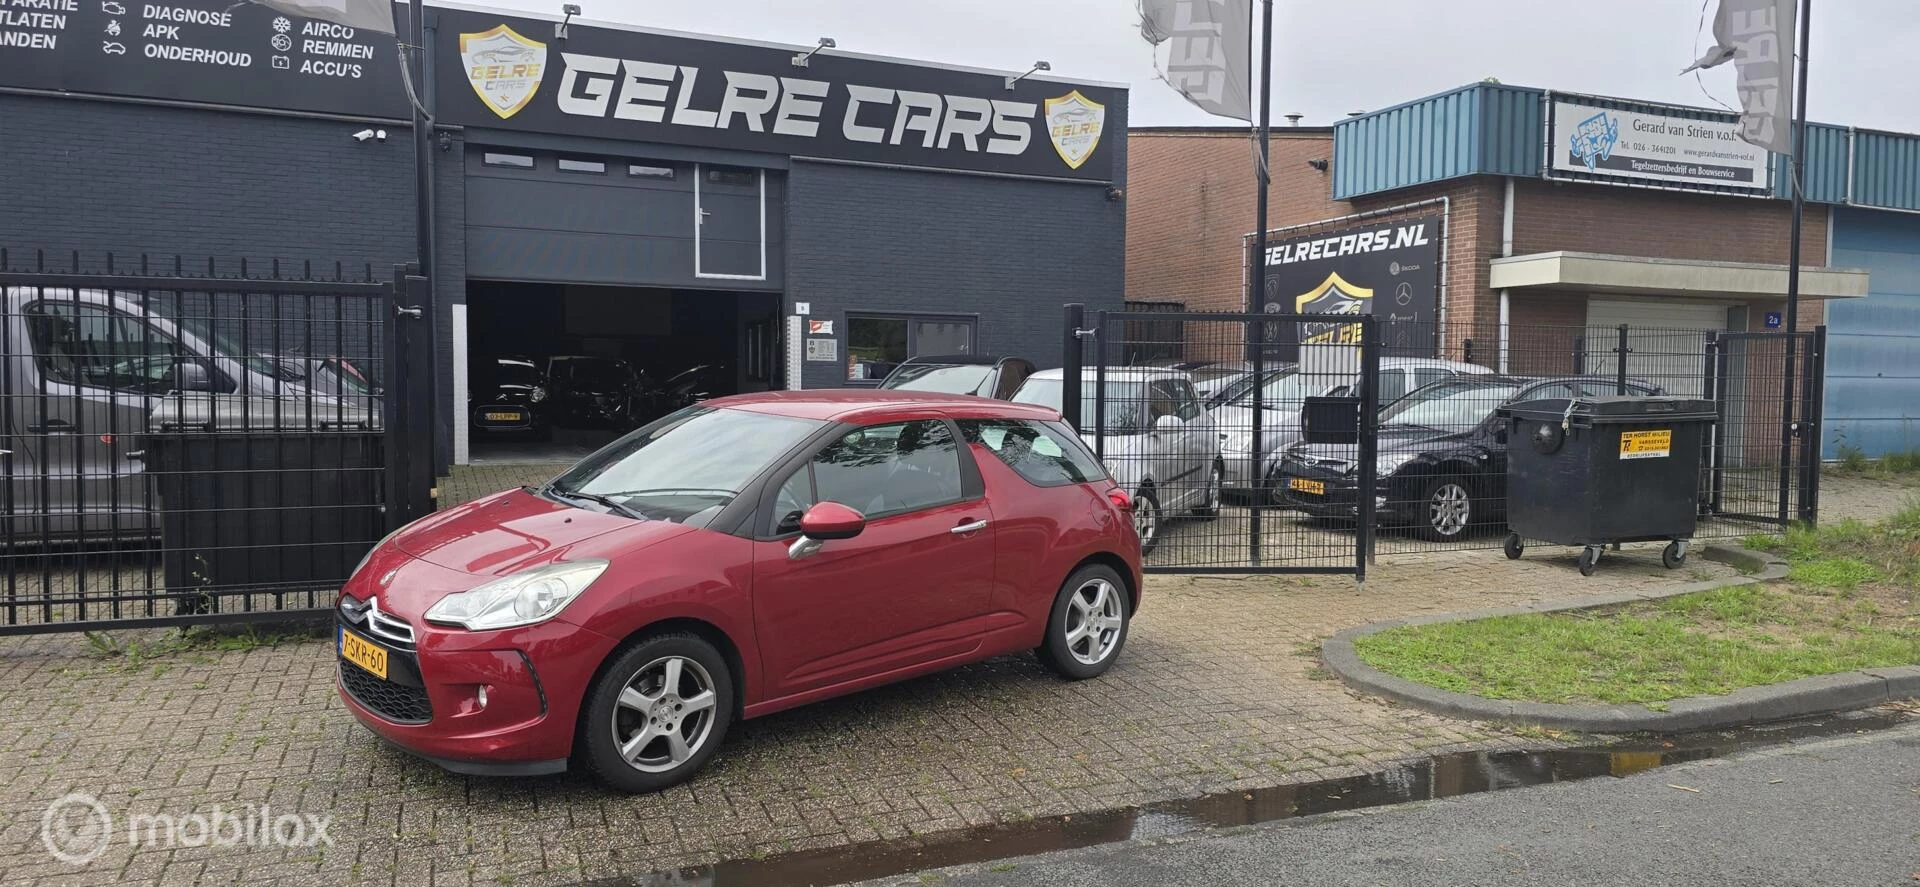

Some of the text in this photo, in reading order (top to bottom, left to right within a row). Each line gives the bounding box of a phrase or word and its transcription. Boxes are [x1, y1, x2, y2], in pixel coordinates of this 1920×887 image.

[143, 4, 232, 27] DIAGNOSE
[143, 23, 181, 41] APK
[301, 21, 355, 40] AIRCO
[0, 31, 57, 50] NDEN
[302, 39, 374, 60] REMMEN
[144, 43, 252, 68] ONDERHOUD
[300, 59, 363, 79] ACCU'S
[471, 64, 541, 79] GELRE
[557, 52, 1038, 156] GELRE CARS
[1633, 119, 1737, 142] Gerard van Strien v.o.f.
[1633, 142, 1646, 151] 026
[1698, 167, 1736, 178] Bouwservice
[1769, 315, 1778, 324] 2a
[343, 633, 384, 673] 7-SKR-60
